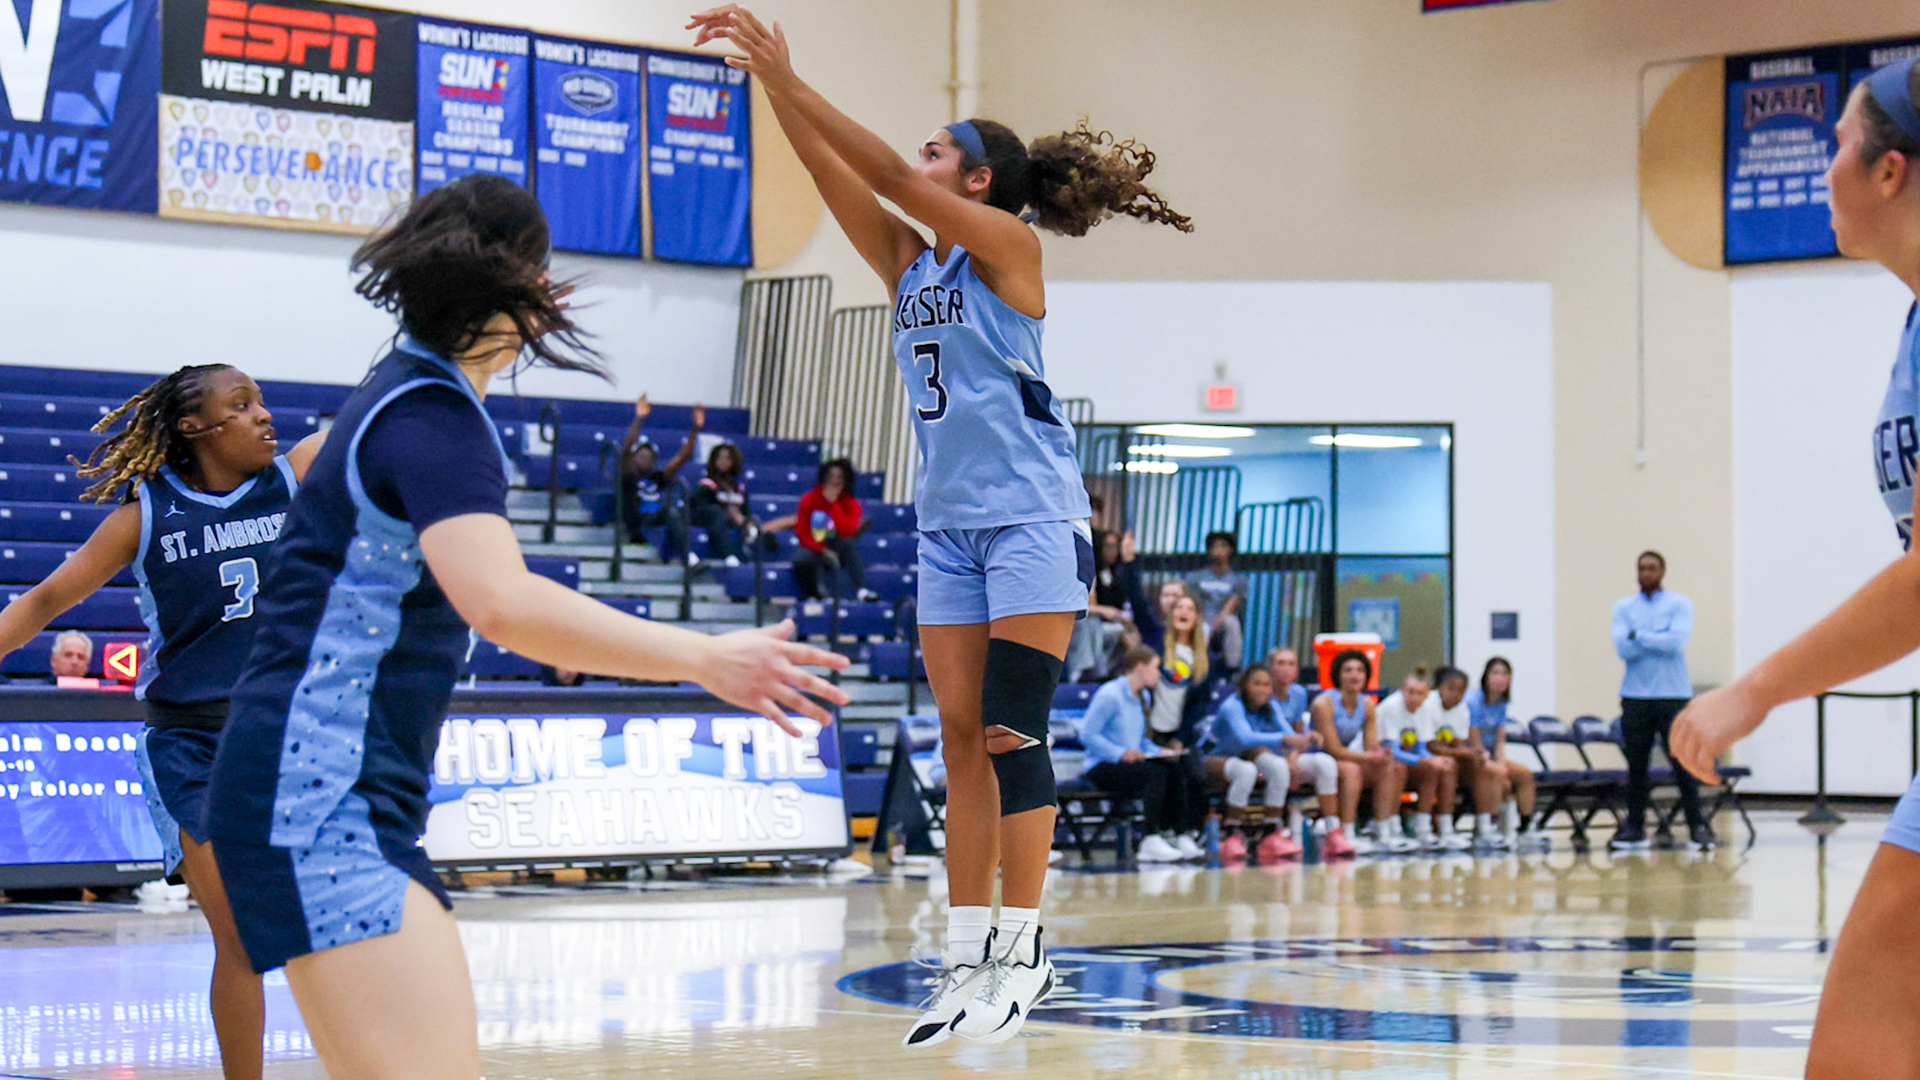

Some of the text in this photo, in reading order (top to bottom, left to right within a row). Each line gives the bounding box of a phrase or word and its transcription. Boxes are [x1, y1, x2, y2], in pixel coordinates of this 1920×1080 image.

[203, 0, 377, 73] ESPN
[201, 59, 372, 107] WEST PALM
[439, 52, 496, 91] SUN
[667, 83, 719, 120] SUN
[912, 340, 948, 424] 3
[1873, 415, 1919, 493] ER
[160, 512, 287, 563] ST. AMBROS
[218, 557, 260, 622] 3
[434, 716, 827, 784] HOME OF THE
[465, 781, 804, 849] SEAHAWKS
